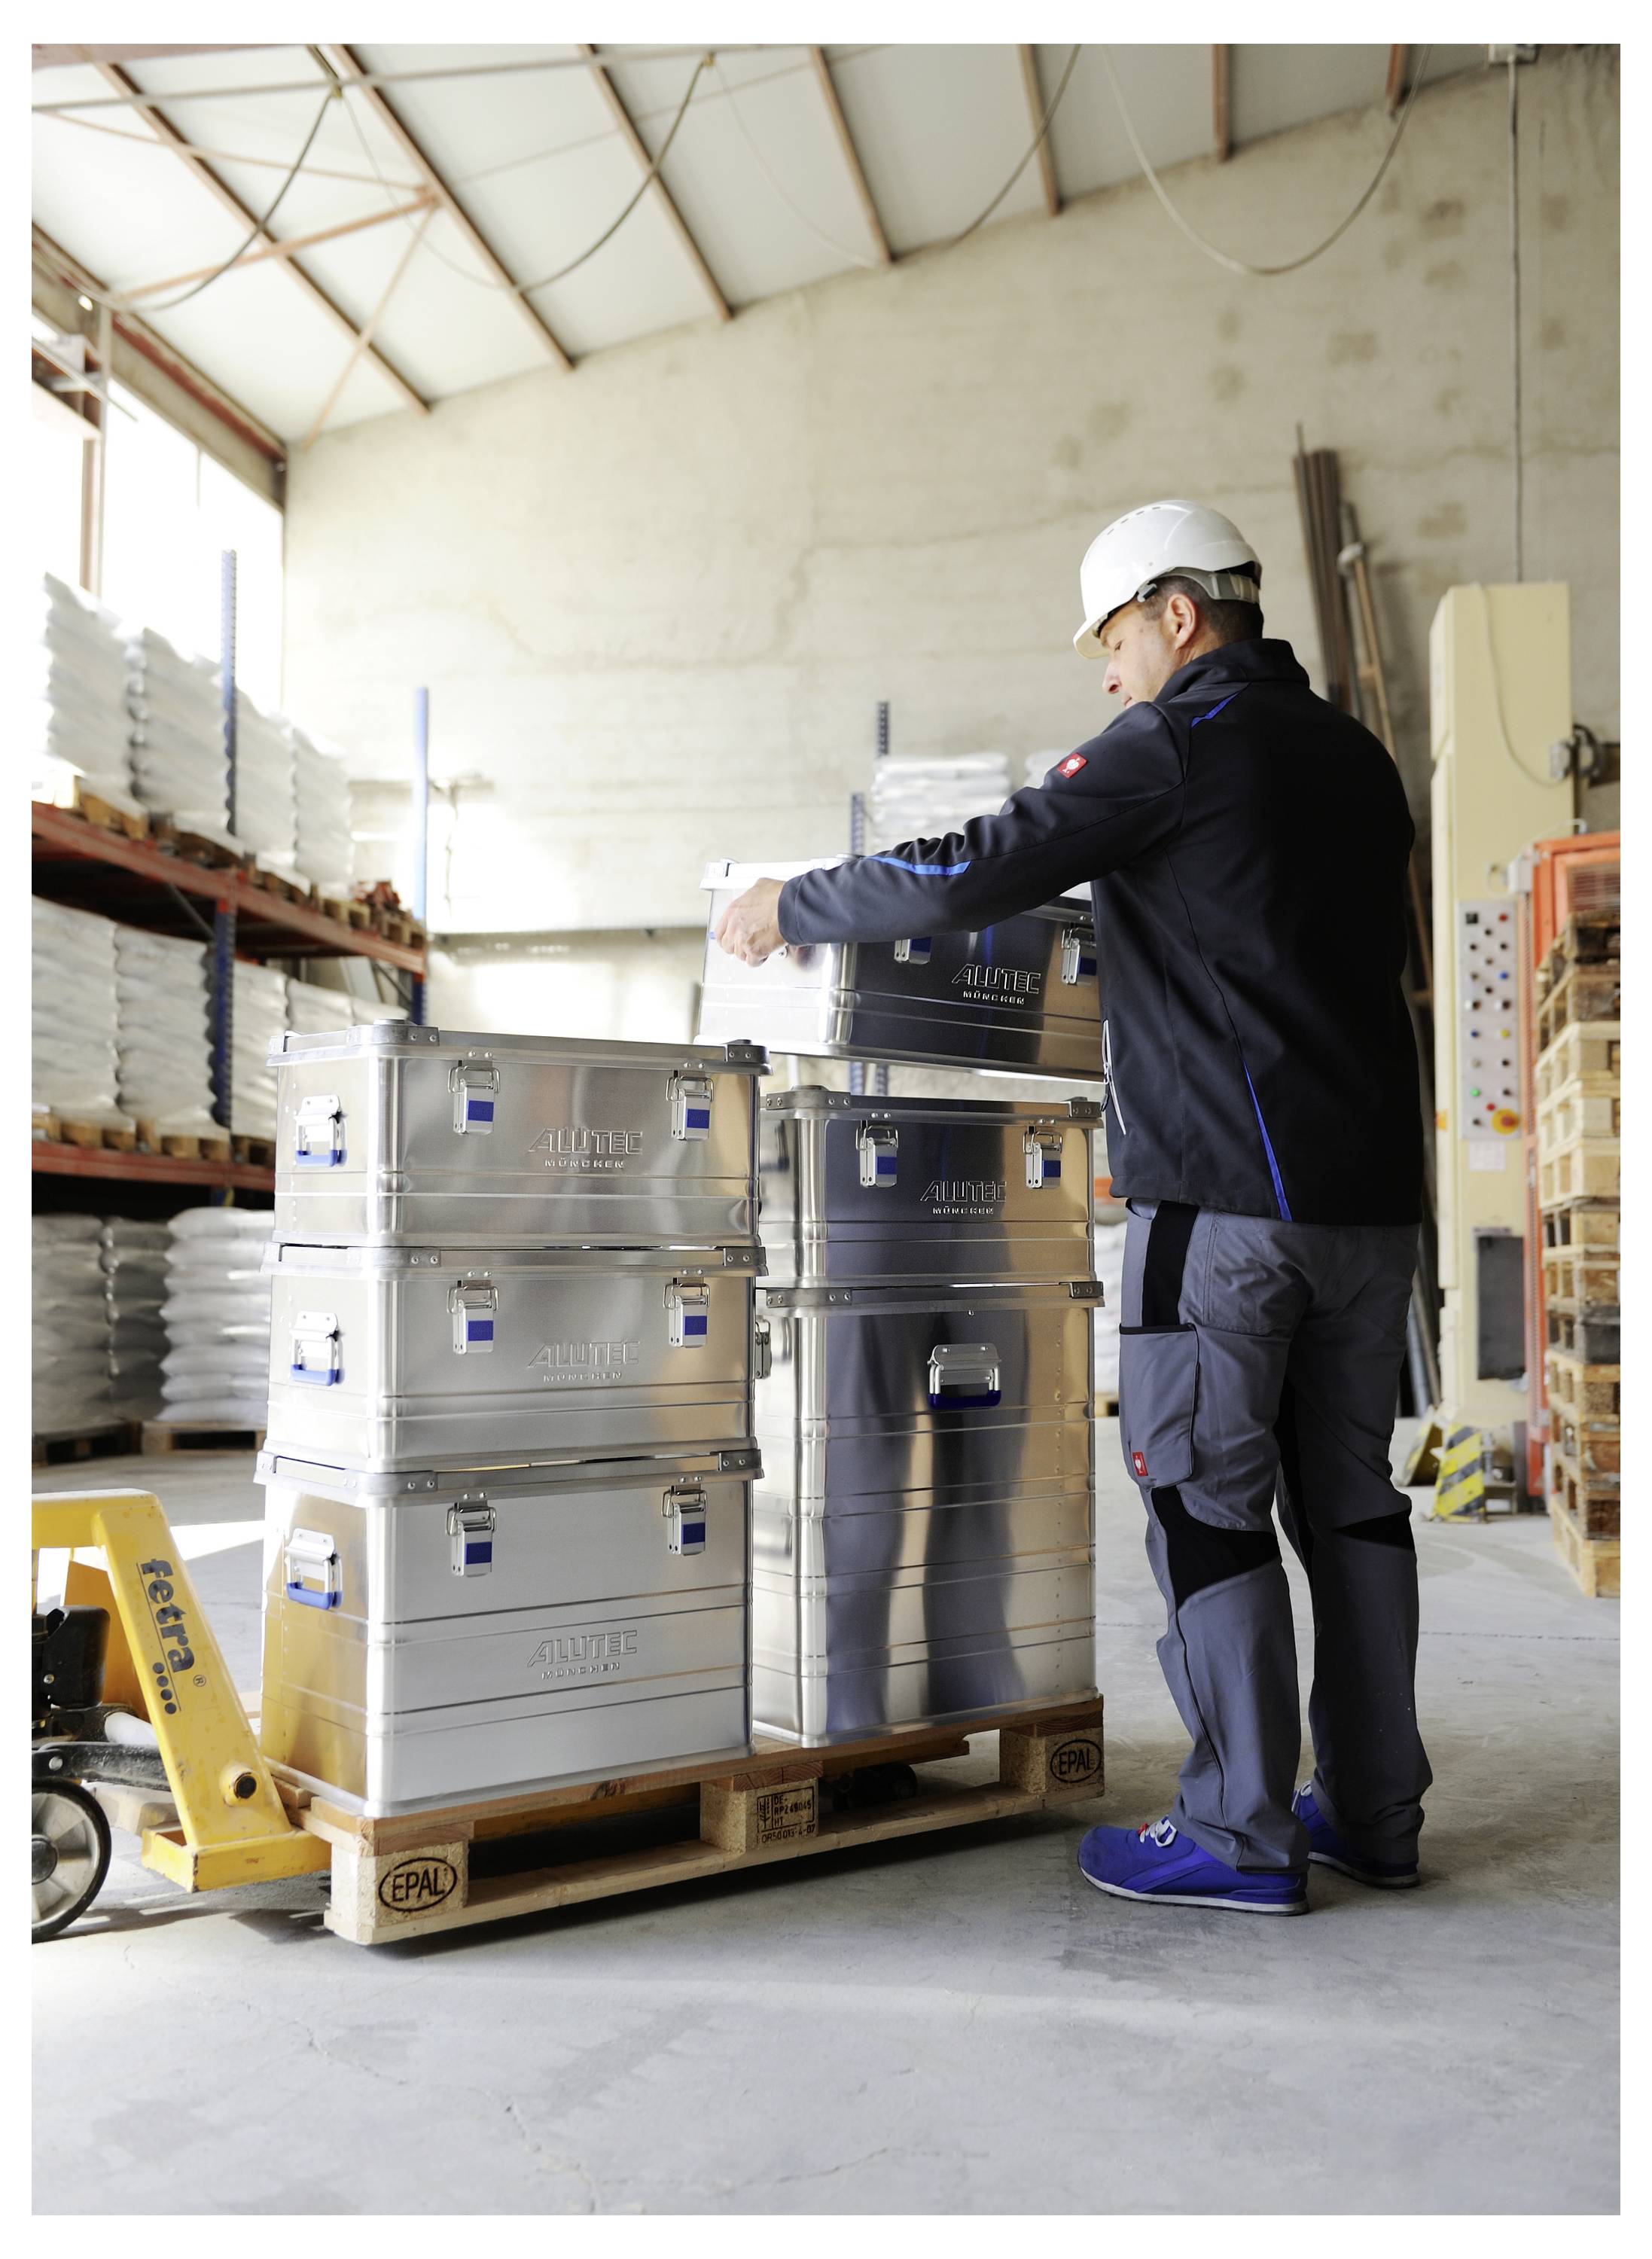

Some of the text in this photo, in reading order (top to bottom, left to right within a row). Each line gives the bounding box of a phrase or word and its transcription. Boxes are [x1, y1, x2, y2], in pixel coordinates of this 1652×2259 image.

[951, 963, 1041, 994] ALUTEC
[963, 989, 1025, 1005] MÜNCHEN
[528, 1128, 643, 1154] ALUTEC
[544, 1157, 624, 1169] MÜNCHEN
[919, 1180, 1007, 1203] ALUTEC
[933, 1206, 994, 1215] MÜNCHEN
[527, 1340, 640, 1368] ALUTEC
[543, 1372, 622, 1383] MÜNCHEN
[140, 1559, 195, 1673] fetra
[527, 1629, 638, 1668] ALUTEC
[541, 1662, 620, 1680] MÜNCHEN
[1059, 1748, 1096, 1776] EPAL
[392, 1867, 446, 1902] EPAL
